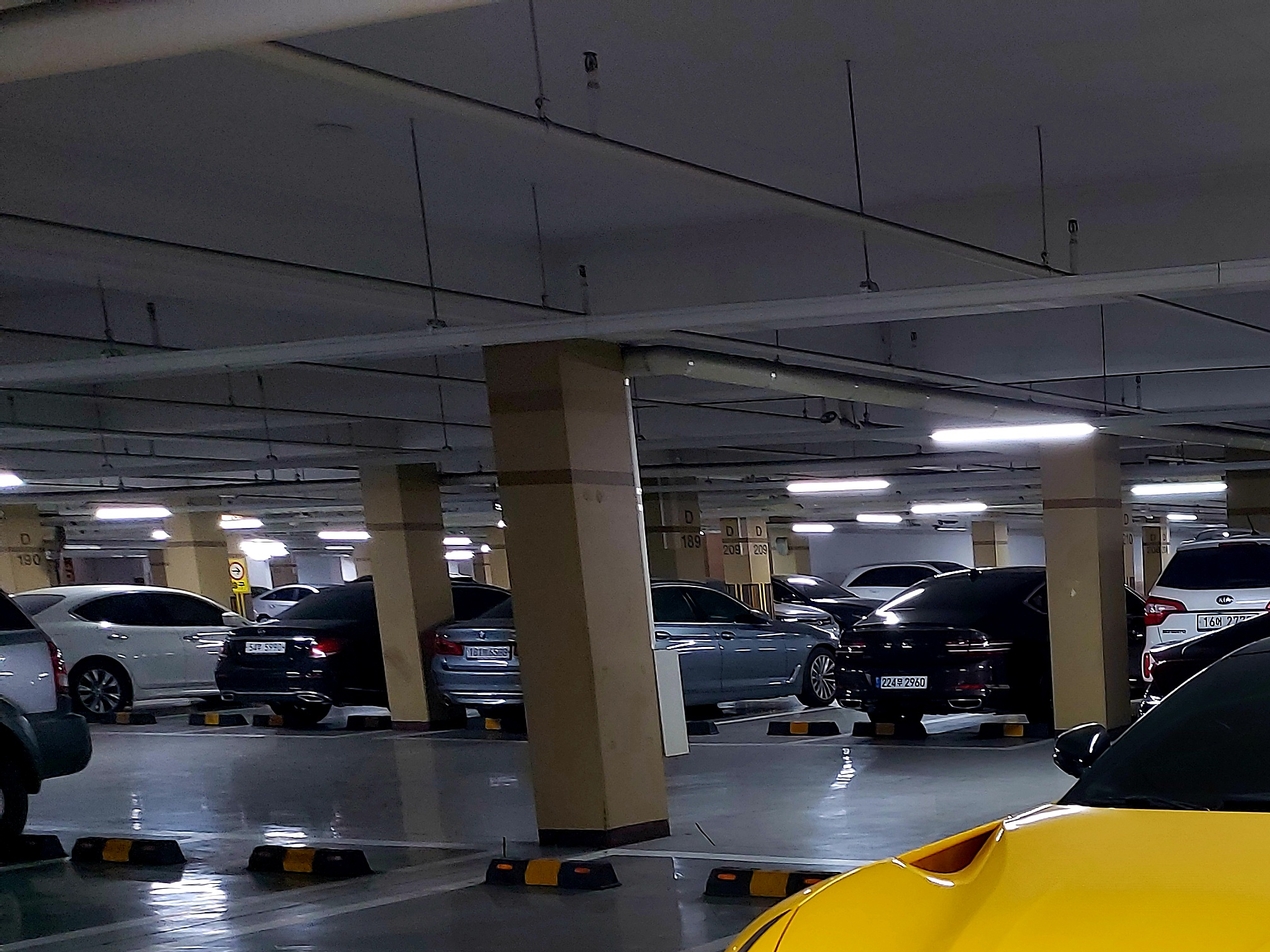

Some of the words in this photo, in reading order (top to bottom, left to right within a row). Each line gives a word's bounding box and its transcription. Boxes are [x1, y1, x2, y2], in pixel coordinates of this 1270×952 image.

[684, 510, 694, 524] D
[726, 525, 734, 536] D
[755, 525, 763, 536] D
[20, 533, 31, 545] D
[681, 534, 701, 548] 189
[723, 544, 741, 555] 209
[753, 544, 768, 555] 209
[17, 554, 41, 566] 190
[904, 677, 926, 688] 2960
